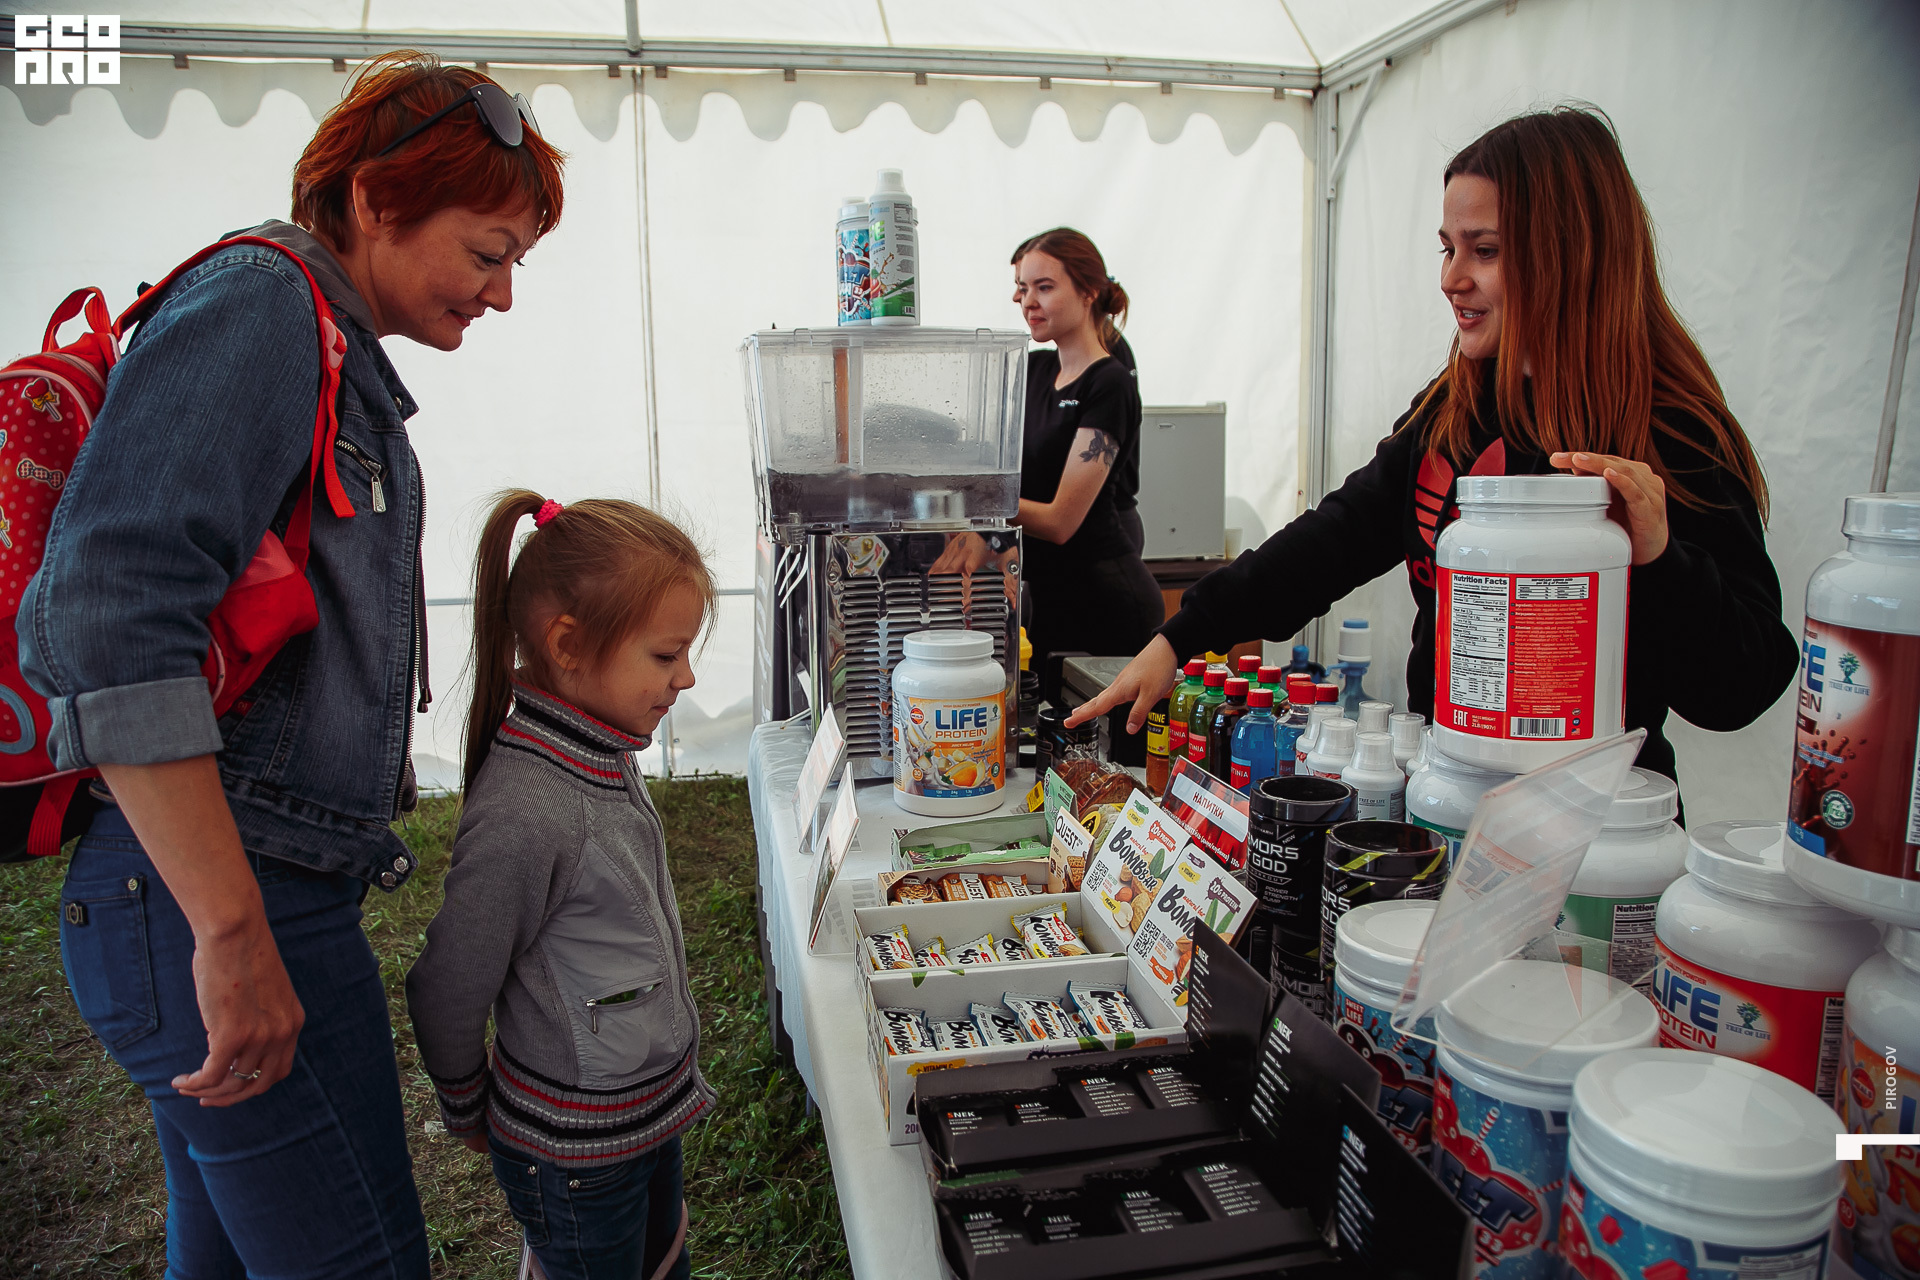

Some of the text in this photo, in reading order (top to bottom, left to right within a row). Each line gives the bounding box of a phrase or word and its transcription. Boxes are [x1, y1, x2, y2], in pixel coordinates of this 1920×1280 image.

[1454, 574, 1508, 586] Nutrition Facts
[935, 707, 988, 730] LIFE
[935, 728, 988, 739] PROTEIN
[1192, 791, 1225, 820] НАПИТКИ
[1056, 815, 1079, 850] QUEST
[1282, 834, 1296, 845] NEW
[1252, 852, 1288, 874] GOD
[1264, 890, 1299, 902] STRENGTH
[1265, 885, 1289, 896] POWER
[1336, 883, 1348, 894] NEW
[1182, 895, 1199, 913] natural
[1220, 890, 1240, 910] PROTEIN
[1262, 896, 1281, 904] PUMP
[1616, 904, 1655, 913] Nutrition
[1195, 945, 1209, 965] SNEK
[1652, 957, 1721, 1034] LIFE
[1345, 997, 1365, 1014] SWEET
[1346, 1008, 1363, 1024] LIFE
[1274, 1016, 1293, 1042] SNEK
[1725, 1023, 1771, 1041] TREE OF LIFE
[1147, 1066, 1175, 1076] SNEK
[1080, 1077, 1108, 1086] SNEK
[1438, 1080, 1452, 1100] LIFE
[1014, 1102, 1042, 1110] SNEK
[947, 1111, 976, 1119] SNEK
[1342, 1124, 1367, 1160] SNEK
